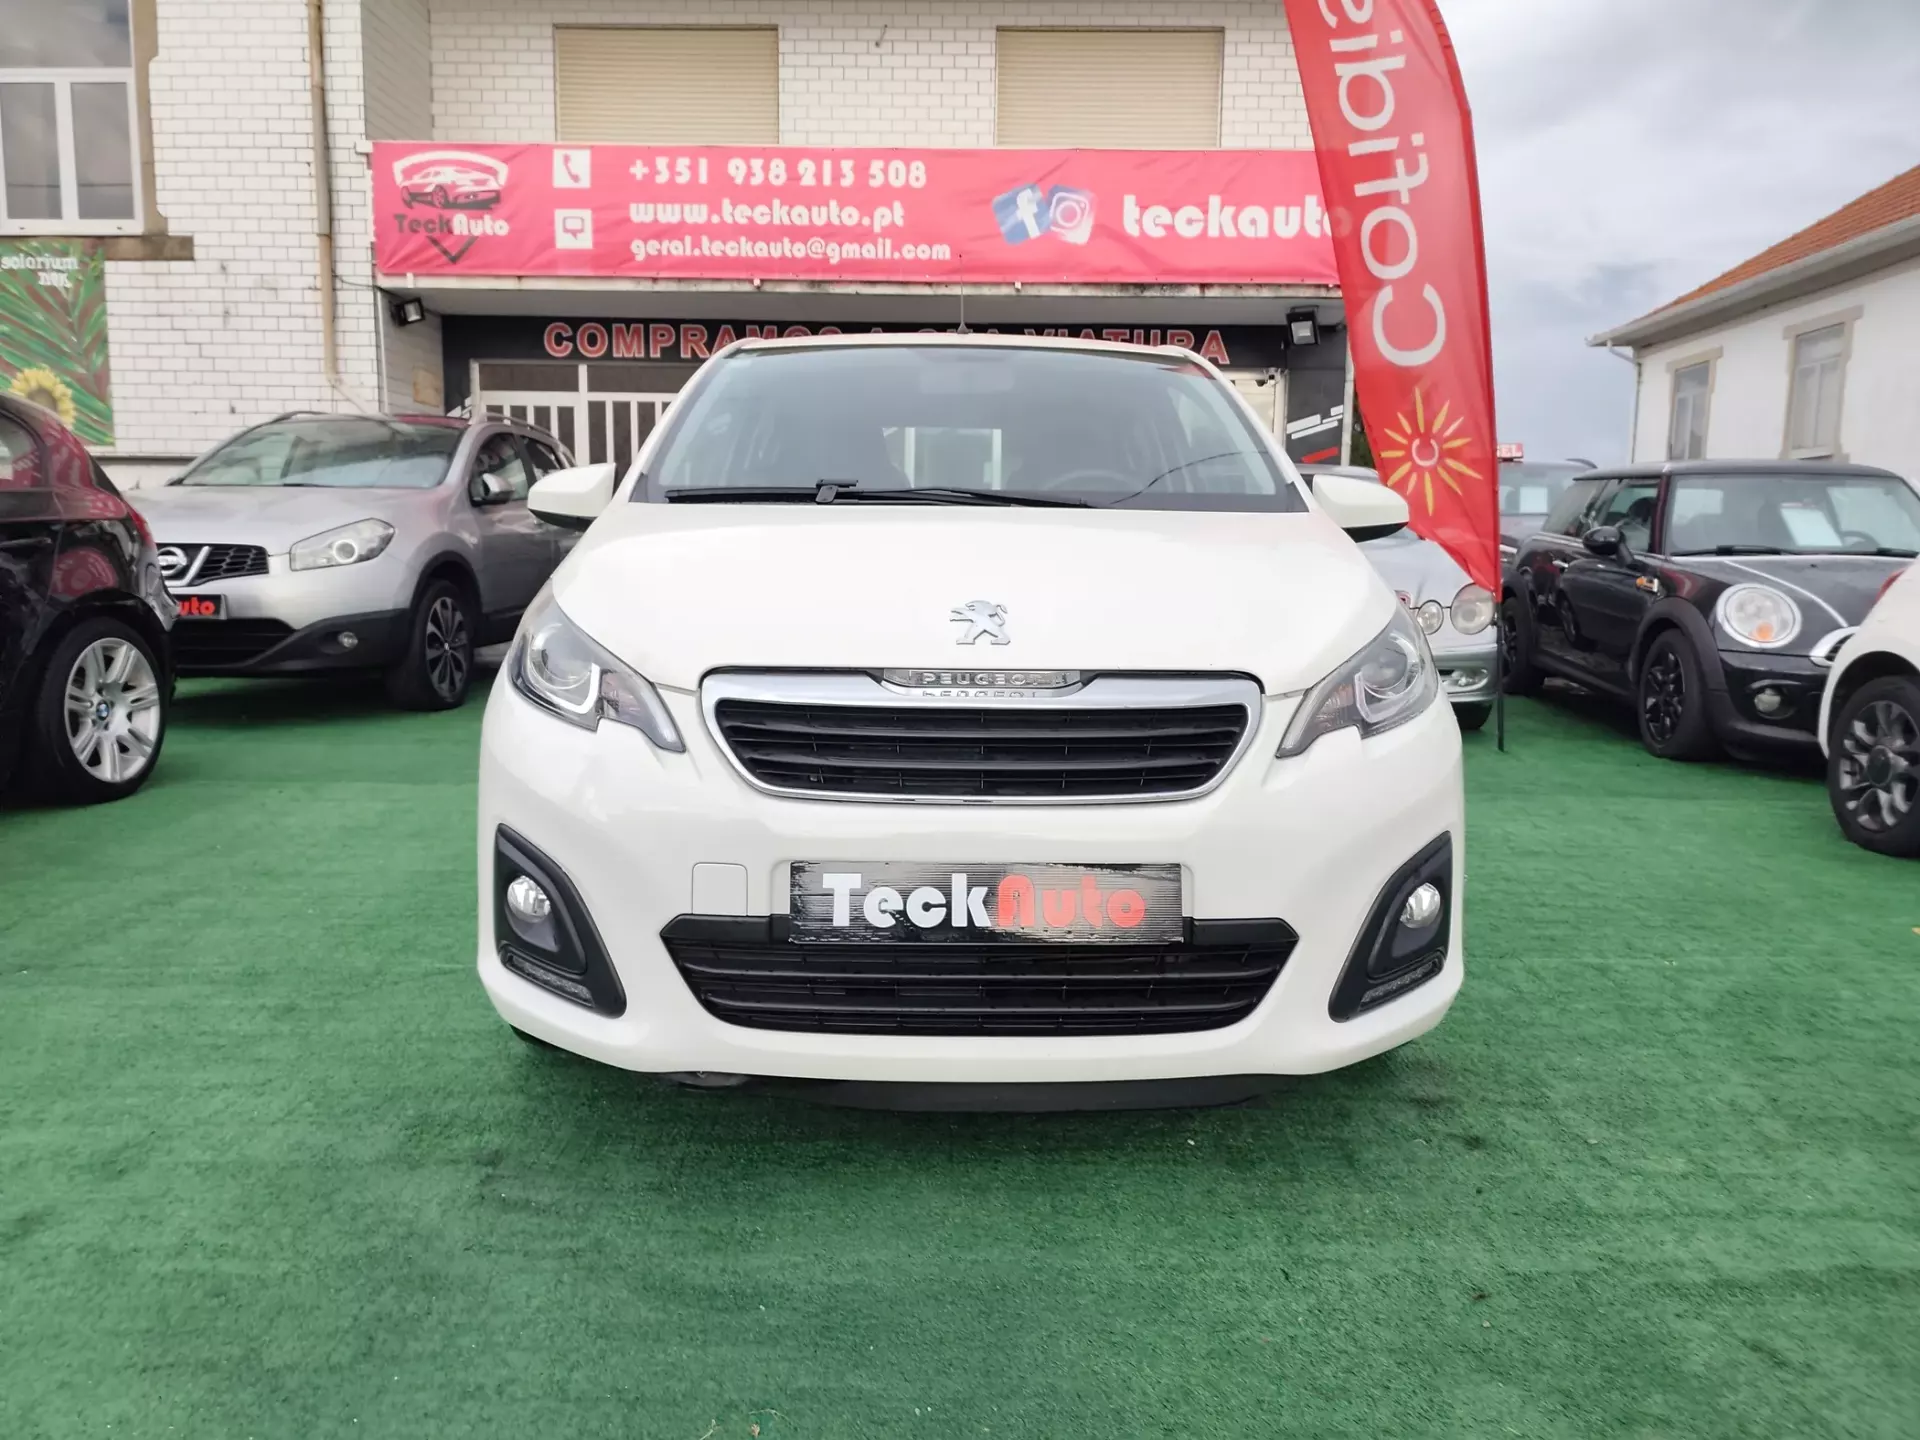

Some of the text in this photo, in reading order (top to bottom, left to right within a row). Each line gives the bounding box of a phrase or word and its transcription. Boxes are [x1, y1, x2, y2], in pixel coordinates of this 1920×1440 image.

[628, 156, 927, 189] +351 938 213 508
[393, 212, 510, 237] TeckAuto
[629, 197, 905, 234] www.teckauto.pt
[630, 234, 951, 265] geral.teckauto@gmail.com
[543, 322, 843, 359] COMPRA
[176, 596, 216, 616] uto
[822, 873, 1146, 929] TeckAuto
